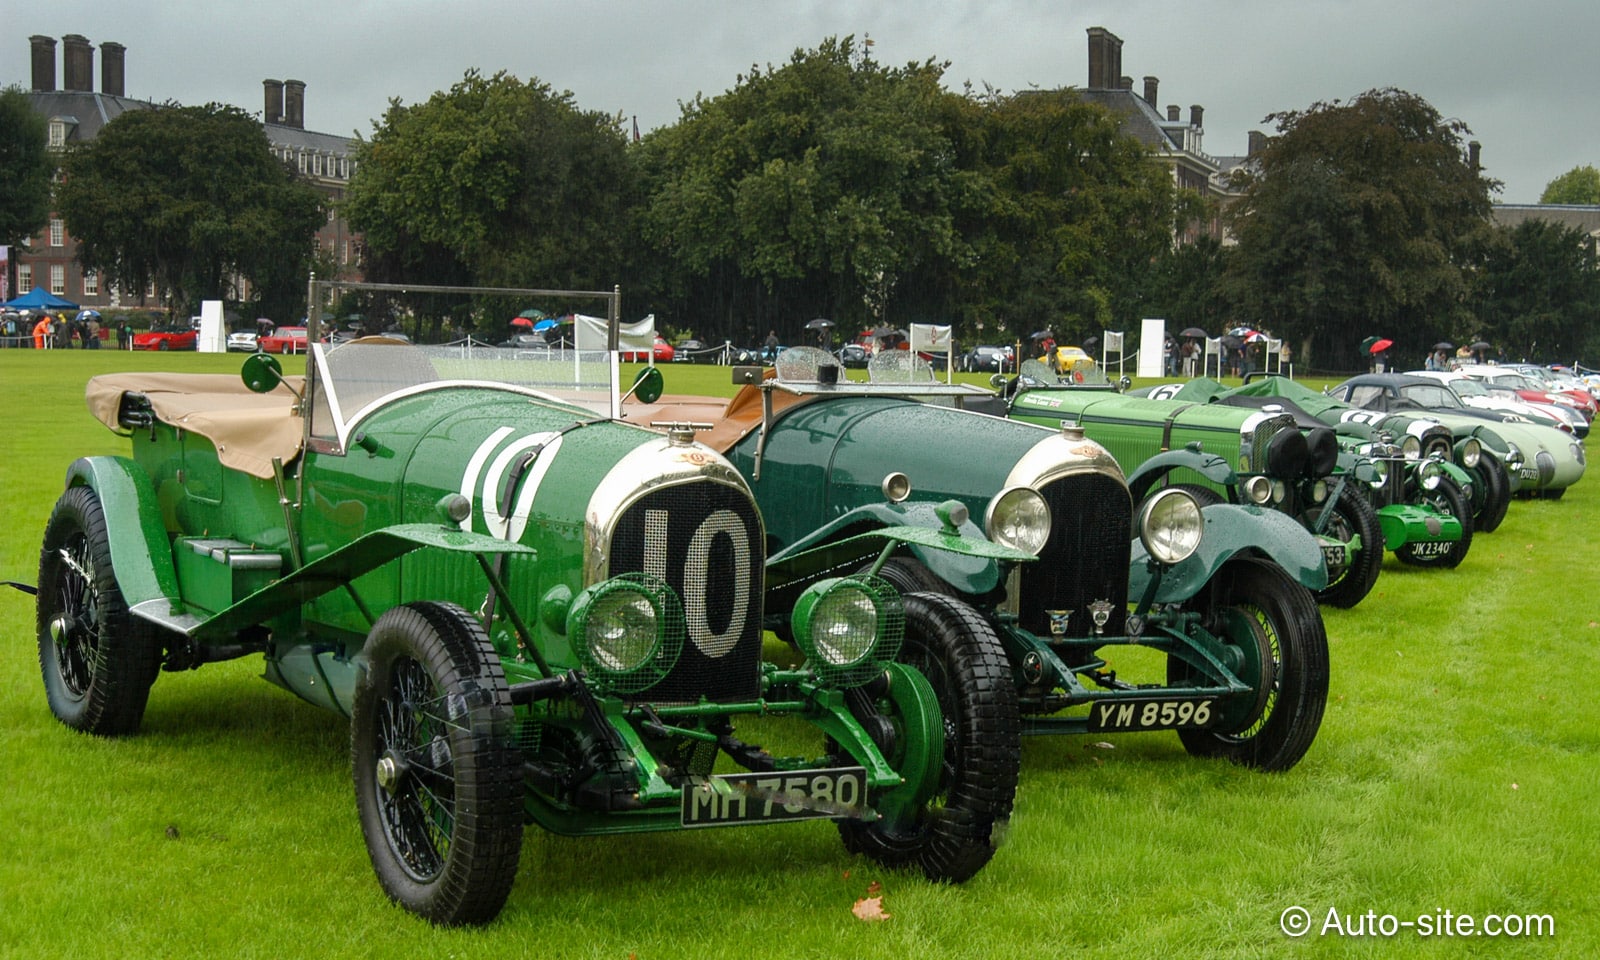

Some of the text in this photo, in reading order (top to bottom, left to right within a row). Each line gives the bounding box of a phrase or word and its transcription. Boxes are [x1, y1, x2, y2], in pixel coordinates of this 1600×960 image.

[460, 426, 563, 543] 10
[1412, 542, 1450, 555] JK 2340
[643, 509, 751, 659] 10
[1099, 700, 1213, 728] YM 8596
[757, 773, 860, 818] 7580
